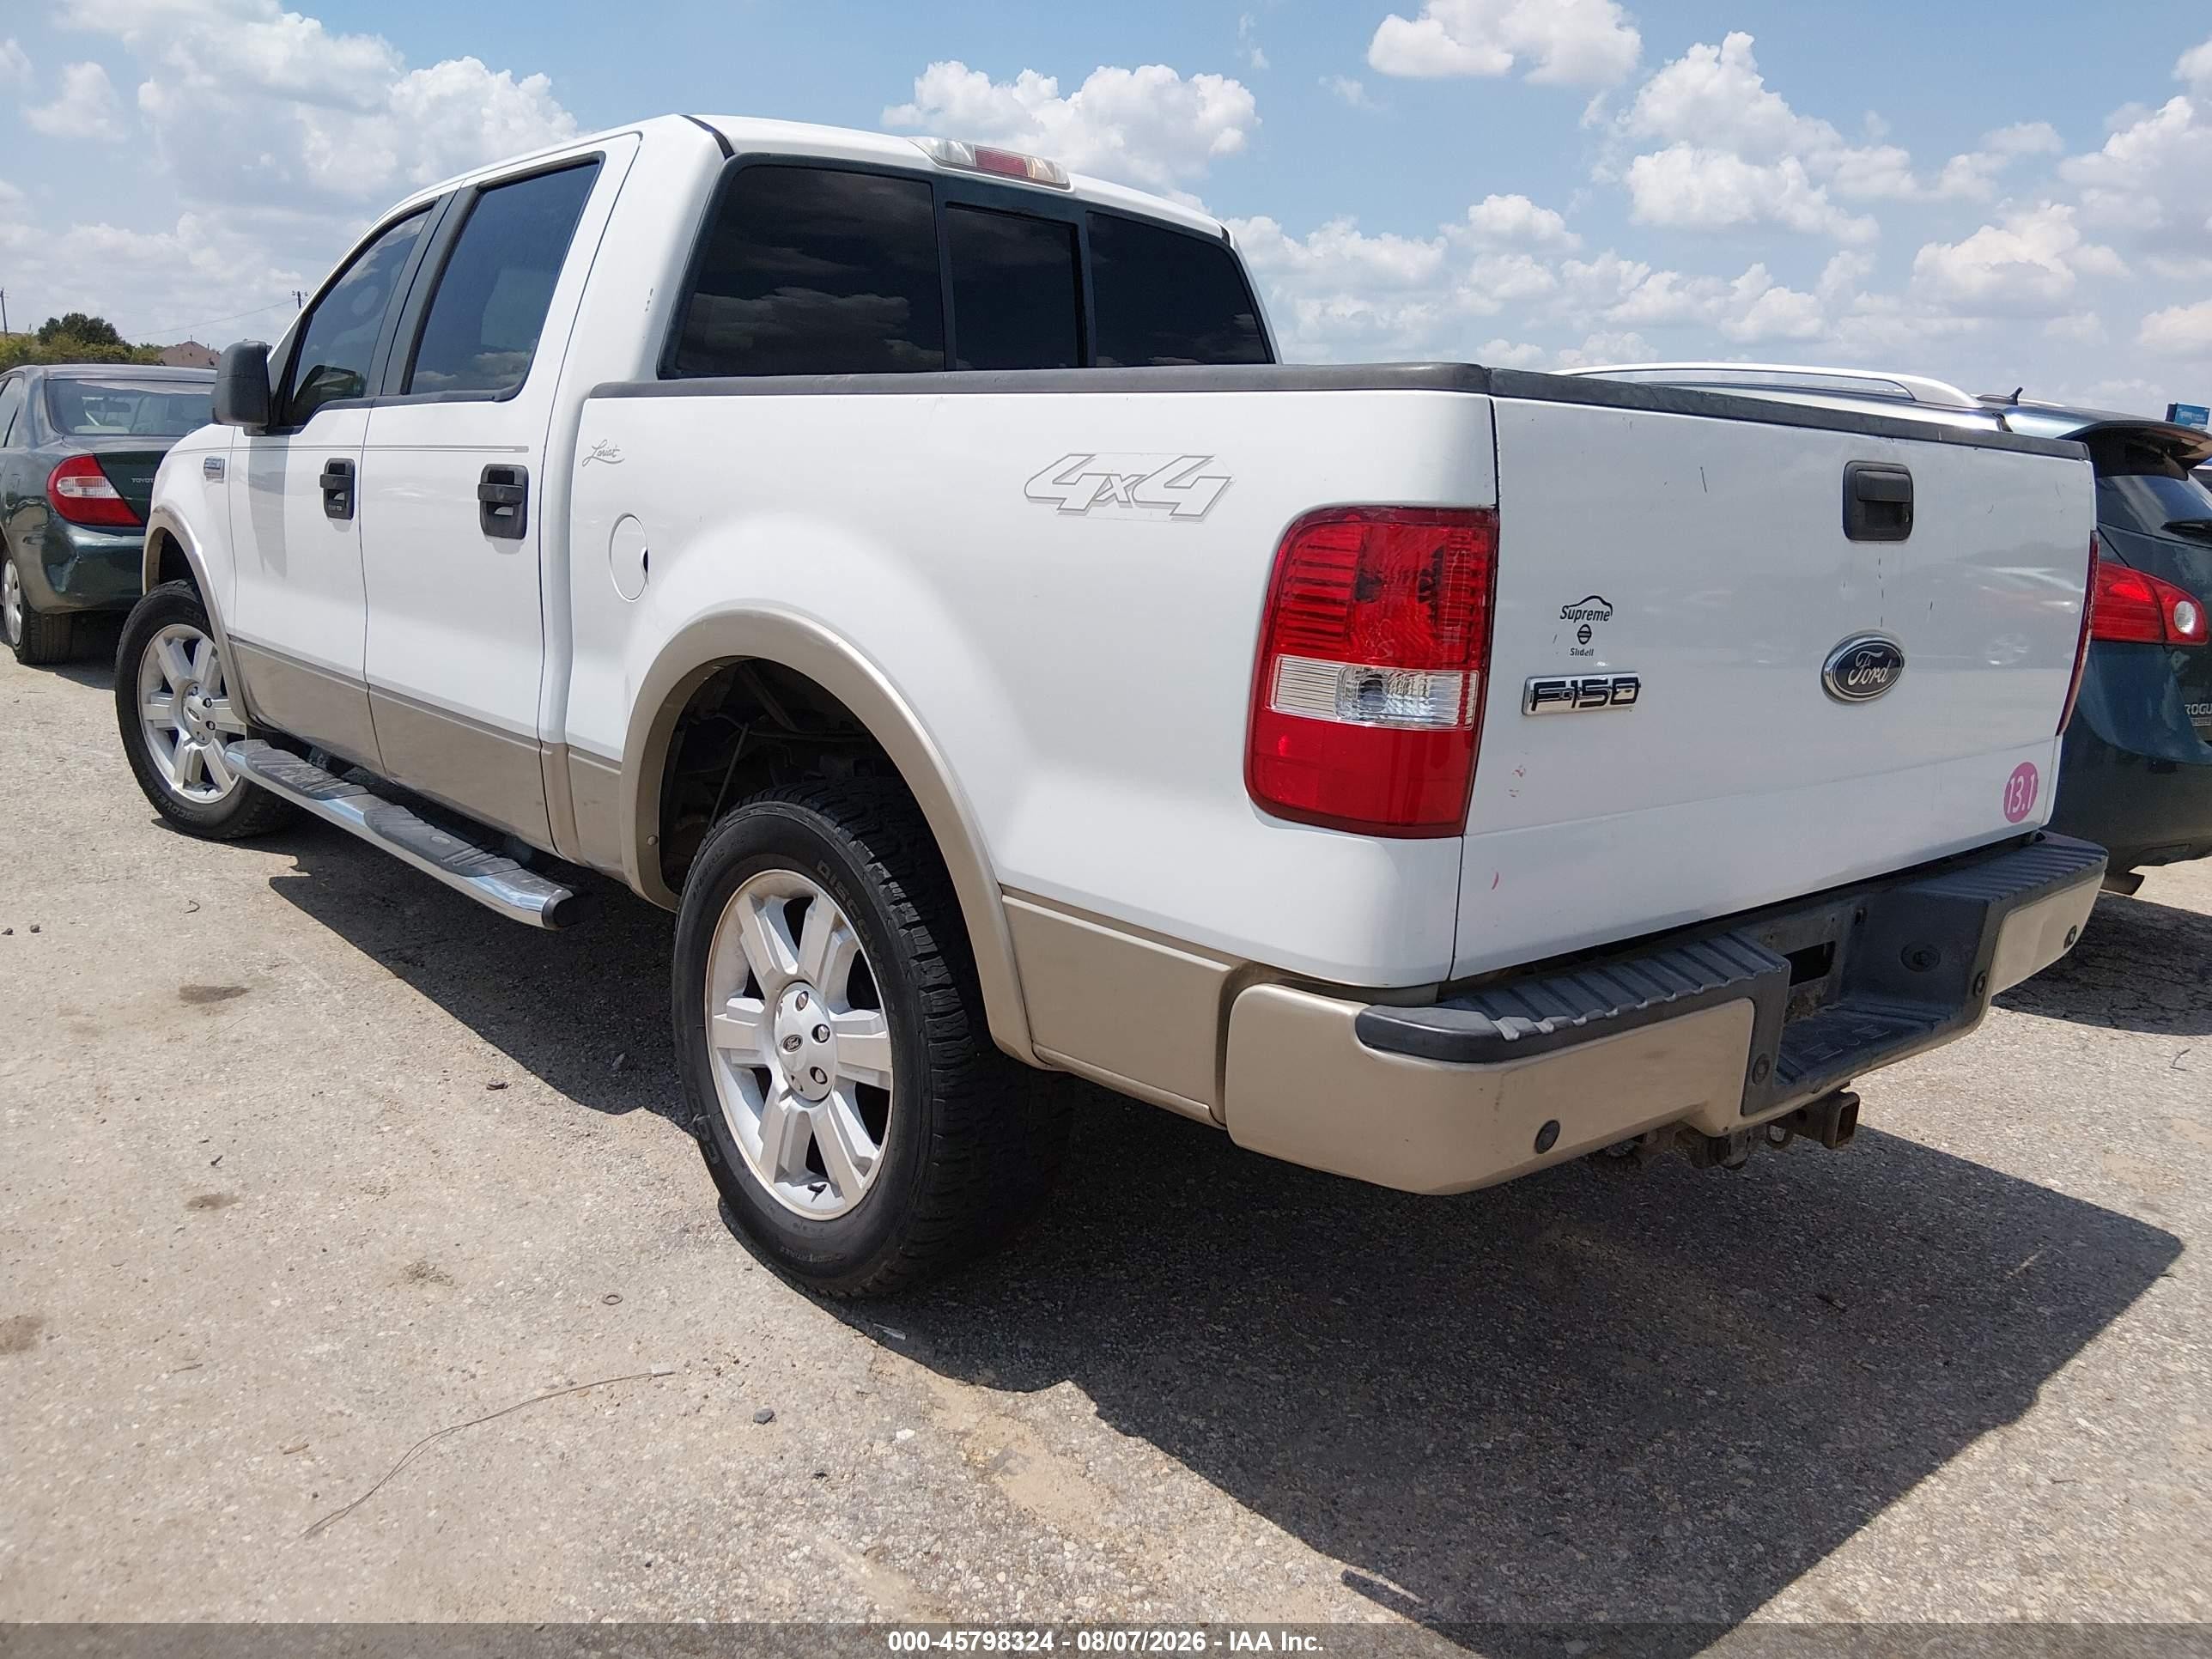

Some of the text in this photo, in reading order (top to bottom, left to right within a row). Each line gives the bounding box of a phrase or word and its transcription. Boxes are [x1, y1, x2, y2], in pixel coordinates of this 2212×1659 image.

[1560, 605, 1611, 623] Supreme
[1570, 647, 1594, 657] Slidell
[1847, 650, 1893, 686] Ford
[2007, 774, 2036, 815] 13.1
